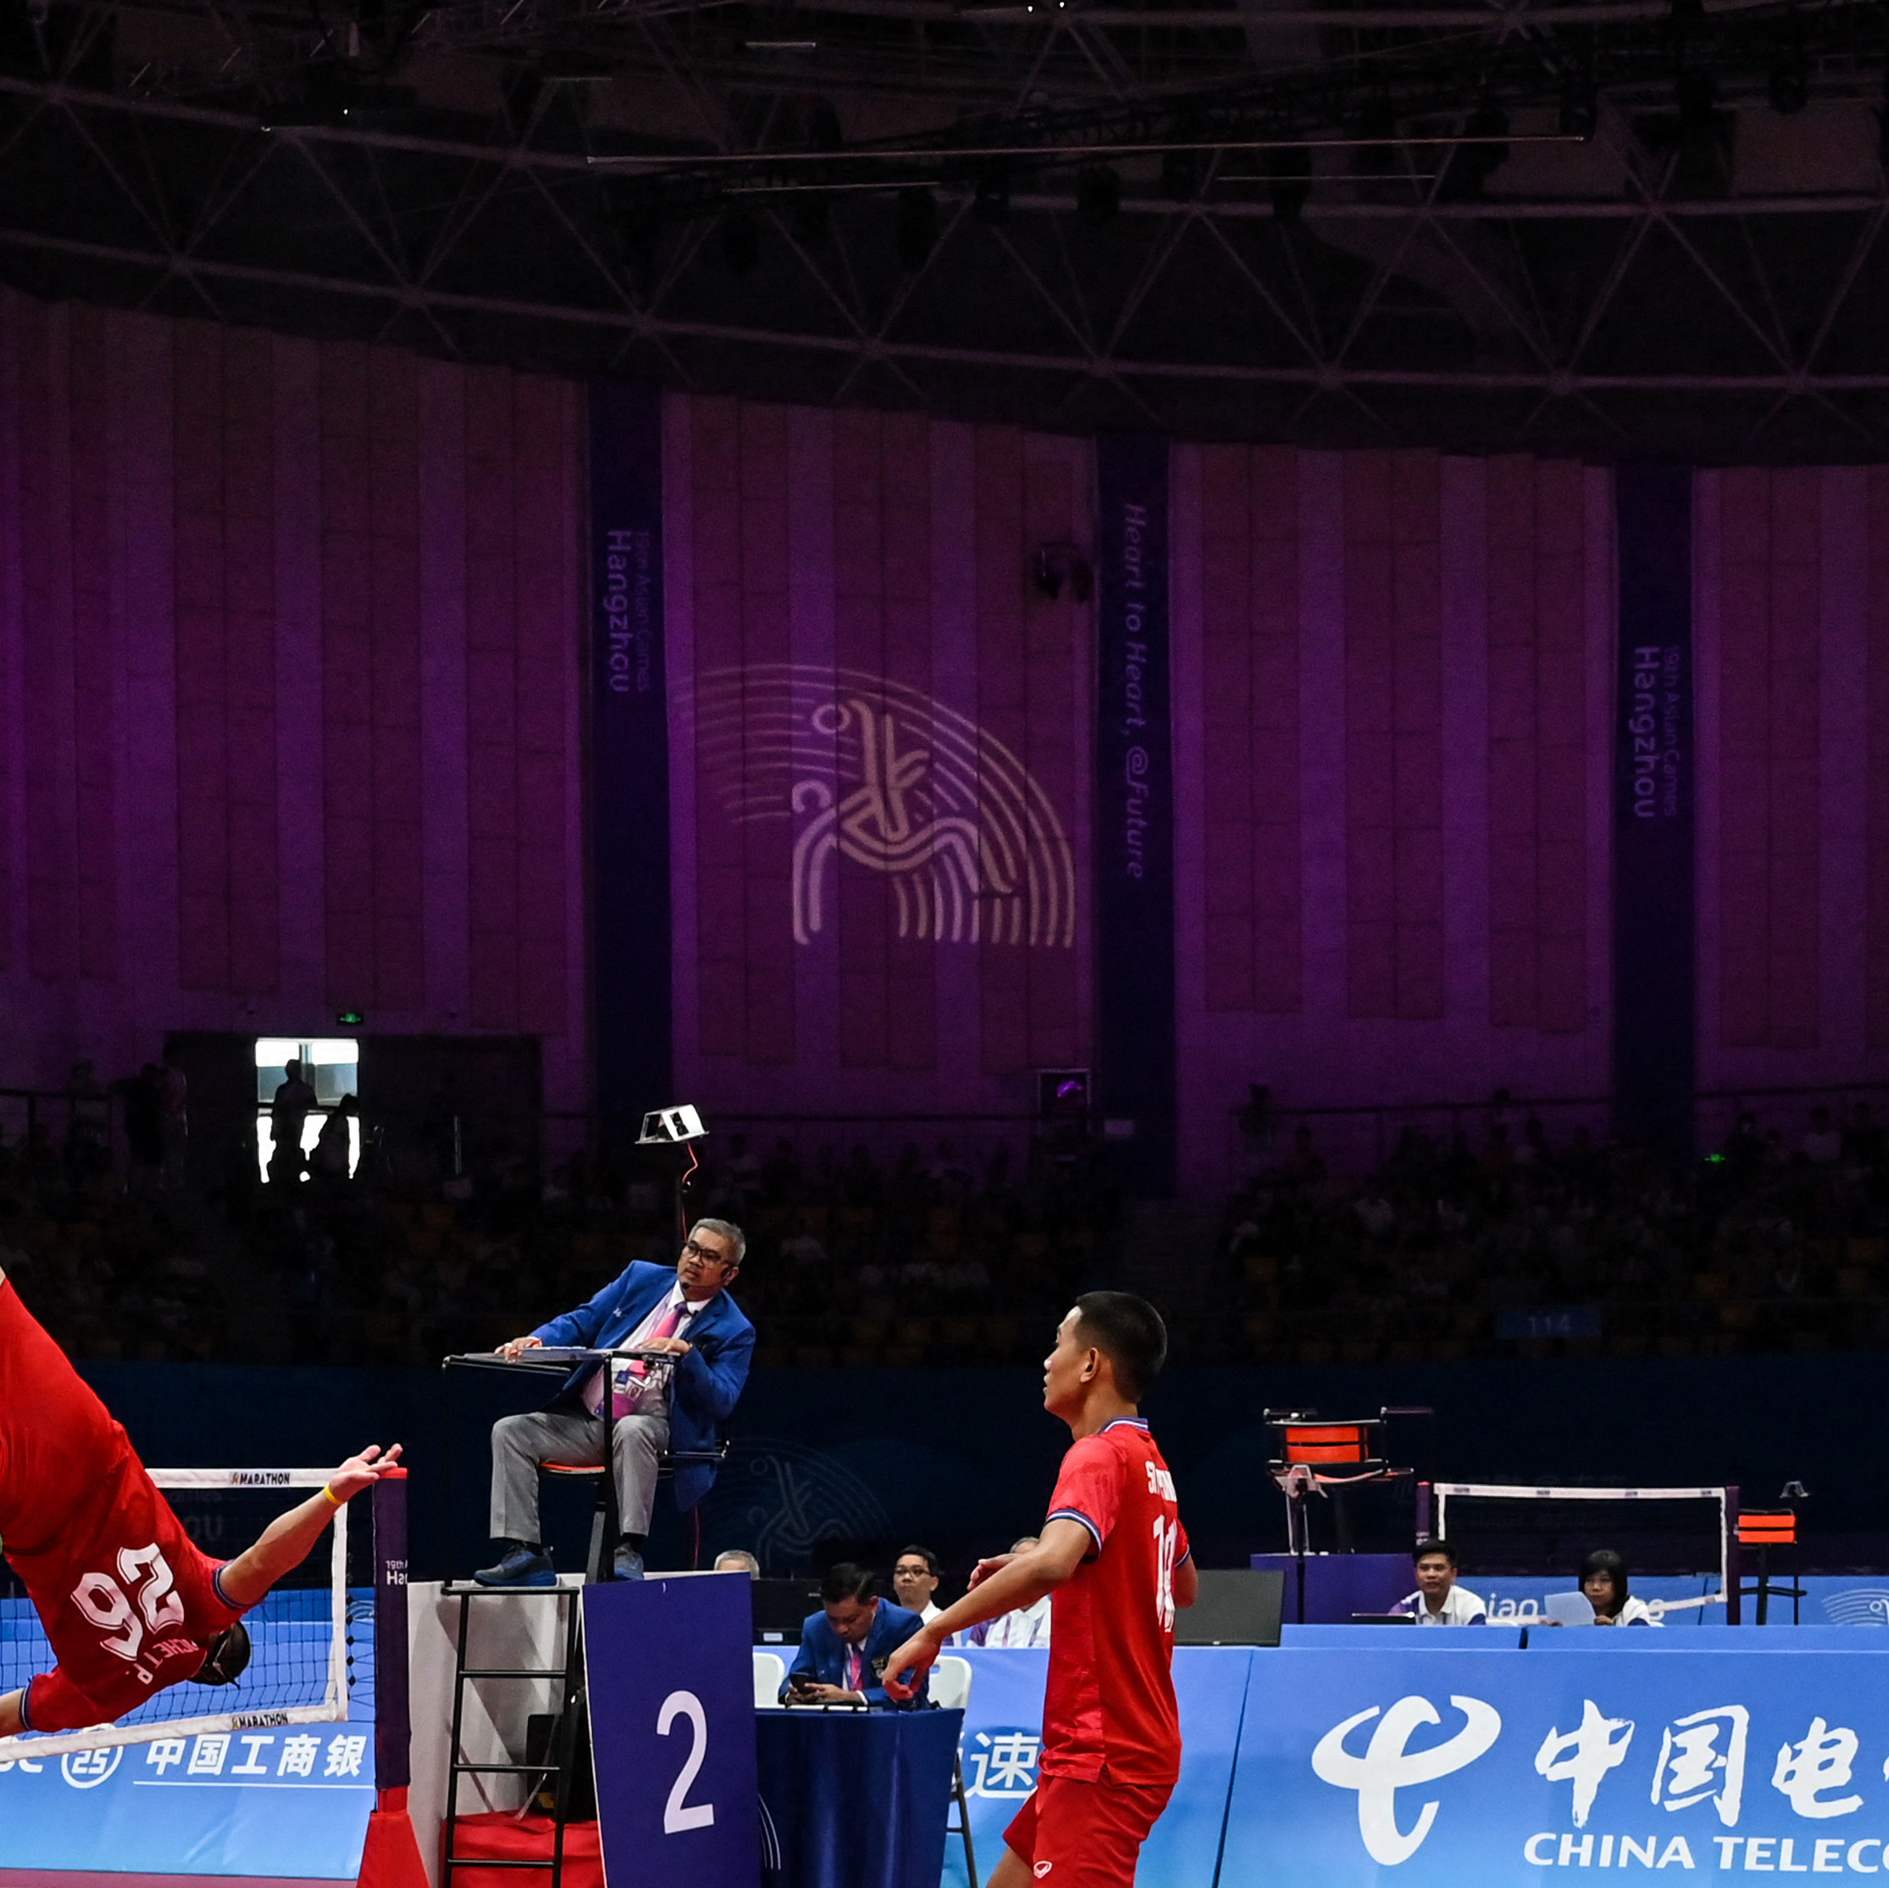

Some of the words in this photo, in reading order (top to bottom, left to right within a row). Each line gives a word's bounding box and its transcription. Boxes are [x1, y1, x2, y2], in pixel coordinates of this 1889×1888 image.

[1124, 502, 1148, 590] Heart
[602, 529, 634, 693] Hangzhou
[1125, 601, 1147, 633] to
[1628, 646, 1661, 818] Hangzhou
[1125, 745, 1150, 880] @Future
[238, 1472, 290, 1486] MARATHON
[69, 1542, 185, 1662] 26
[238, 1712, 288, 1729] MARATHON
[656, 1690, 714, 1835] 2
[1523, 1832, 1696, 1870] CHINA
